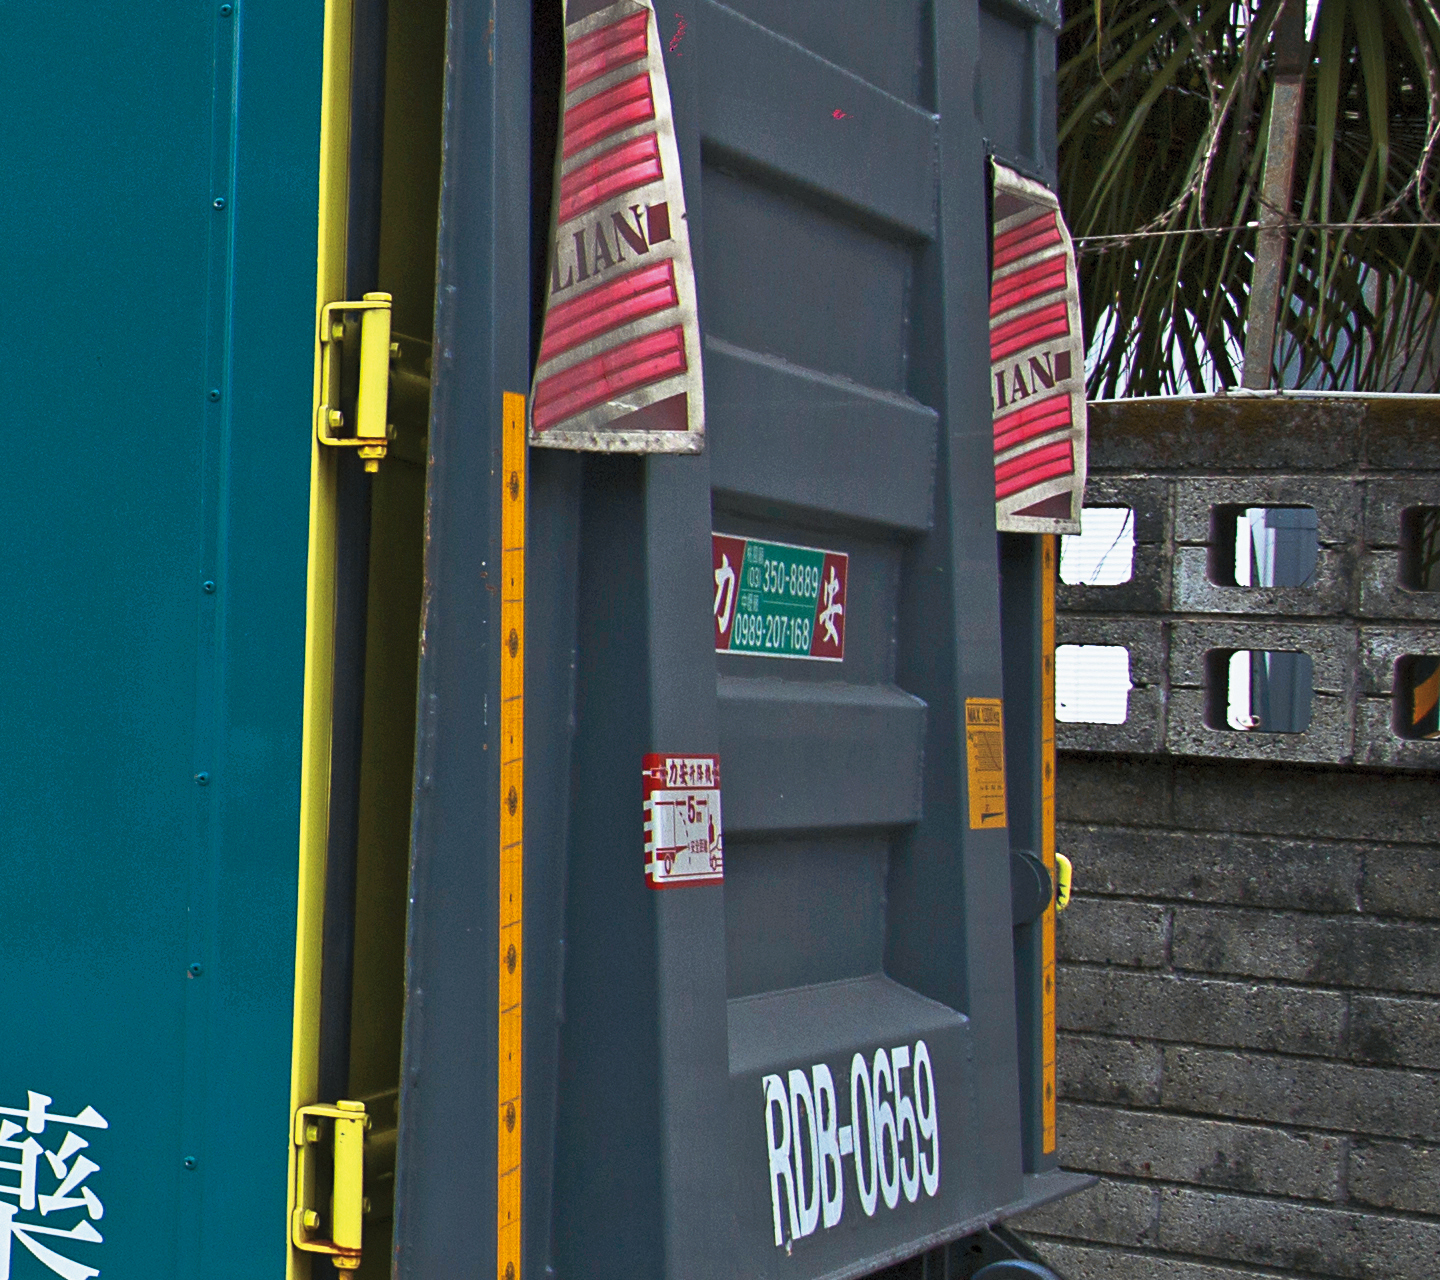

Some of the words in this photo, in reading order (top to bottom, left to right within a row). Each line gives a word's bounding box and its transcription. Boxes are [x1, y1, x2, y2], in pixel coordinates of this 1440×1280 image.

[762, 559, 819, 598] 350-8889
[819, 565, 843, 647] 安
[762, 1040, 940, 1247] RDB-0659
